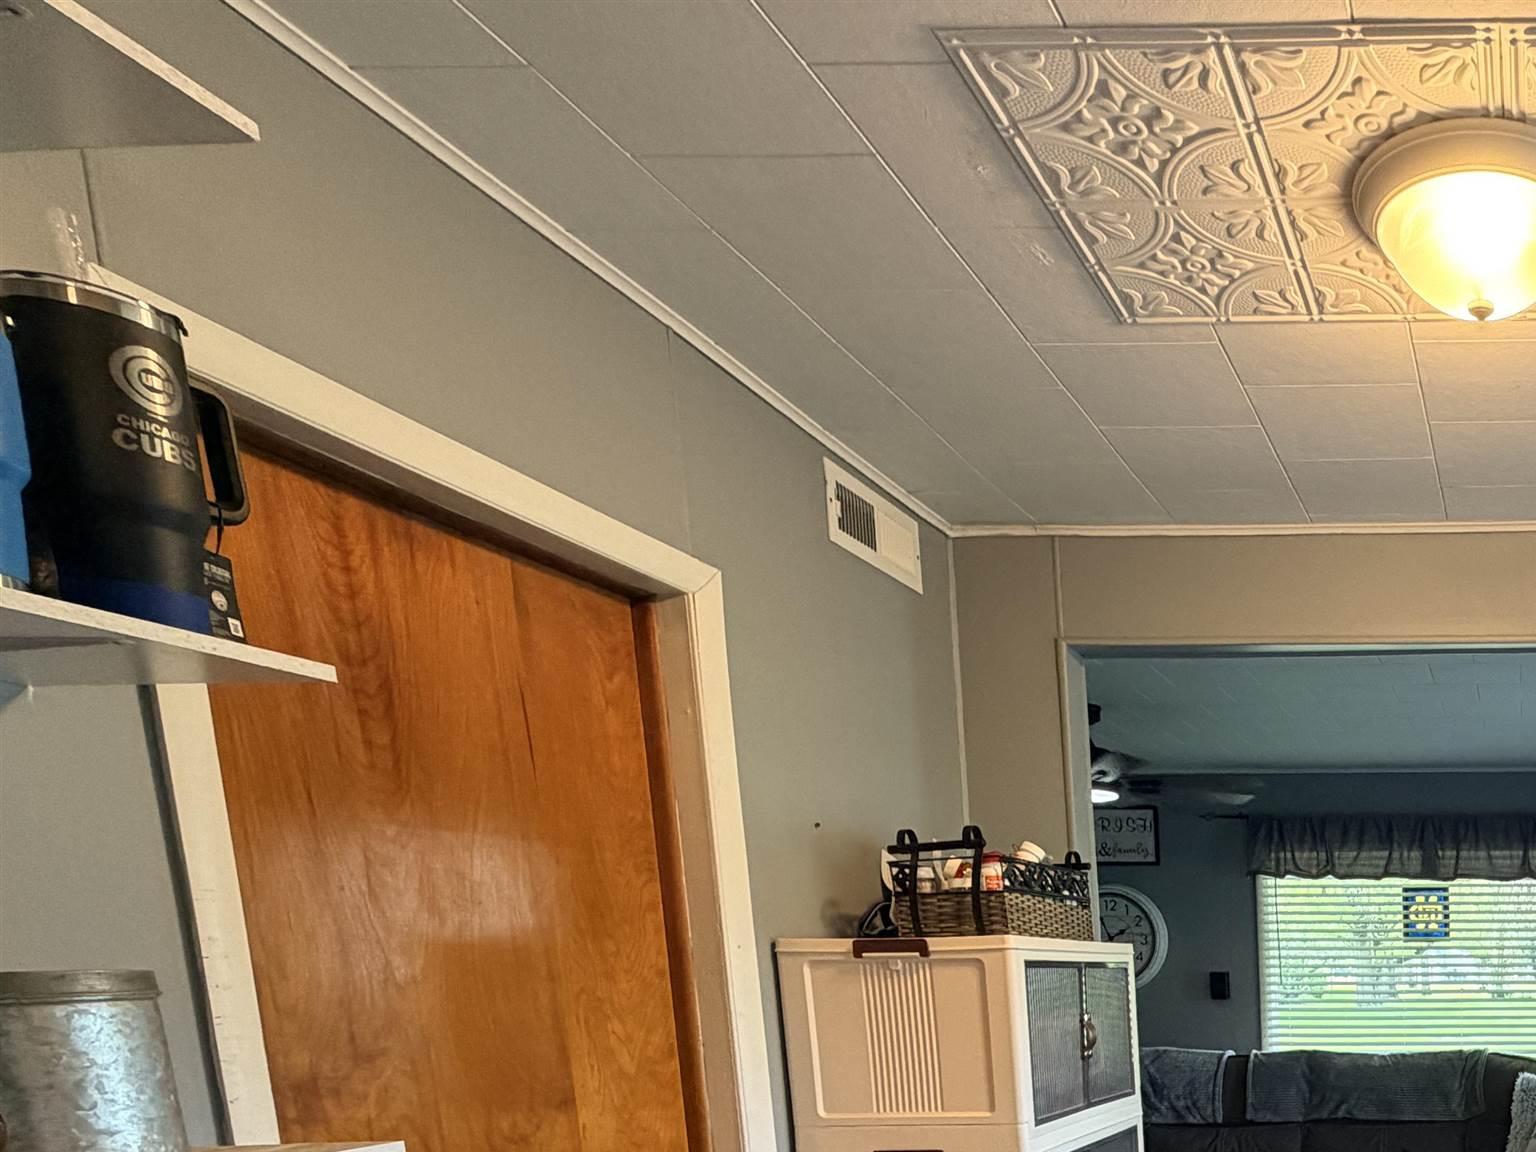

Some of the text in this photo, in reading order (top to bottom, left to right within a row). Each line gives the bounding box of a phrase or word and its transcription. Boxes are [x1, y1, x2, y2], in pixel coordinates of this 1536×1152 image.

[116, 414, 191, 445] CHICAGO
[112, 427, 196, 471] CUBS
[1103, 899, 1117, 912] 12
[1124, 904, 1129, 916] 1
[1134, 915, 1143, 928] 2
[1140, 934, 1149, 946] 3
[1135, 952, 1144, 962] 4
